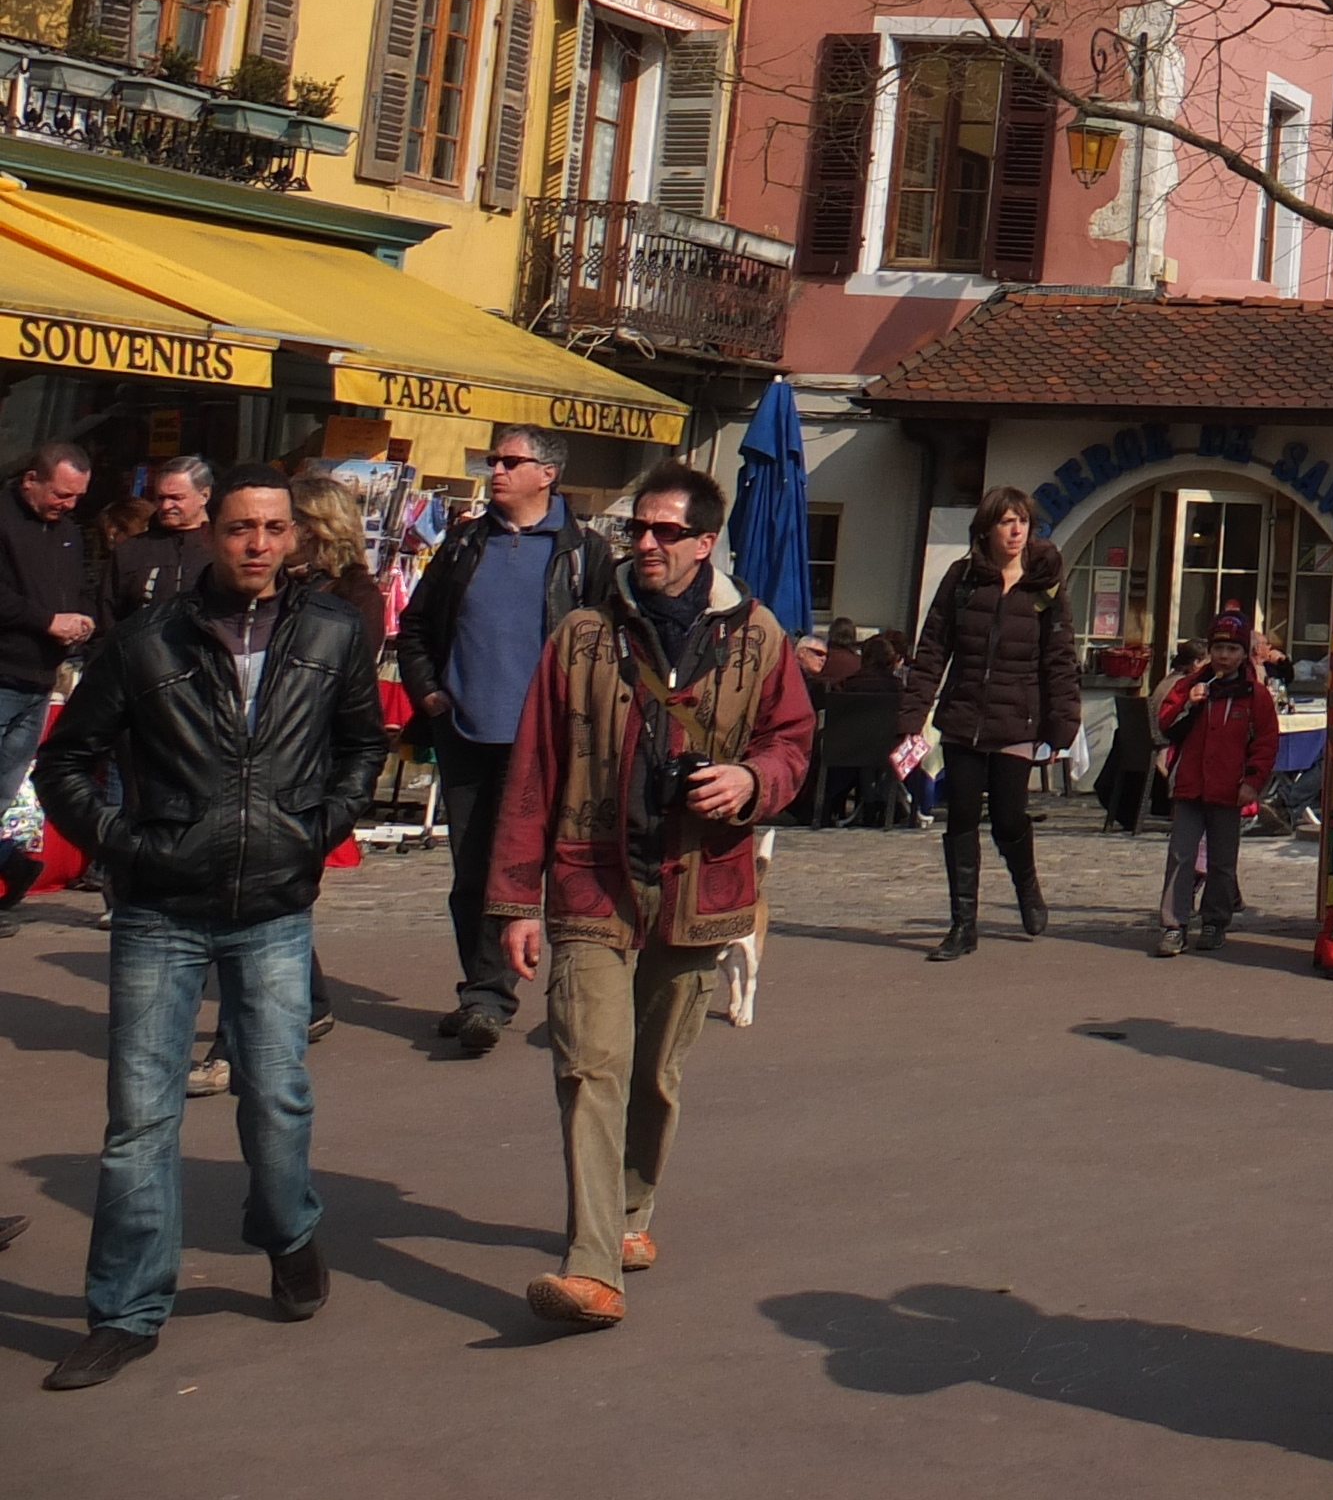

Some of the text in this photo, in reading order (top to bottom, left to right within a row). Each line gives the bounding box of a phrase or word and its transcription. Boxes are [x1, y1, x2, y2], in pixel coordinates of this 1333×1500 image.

[18, 317, 234, 381] SOUVENIRS
[377, 372, 656, 440] TABAC CADEAUX
[1033, 422, 1176, 539] BERGE
[1196, 423, 1257, 465] DE
